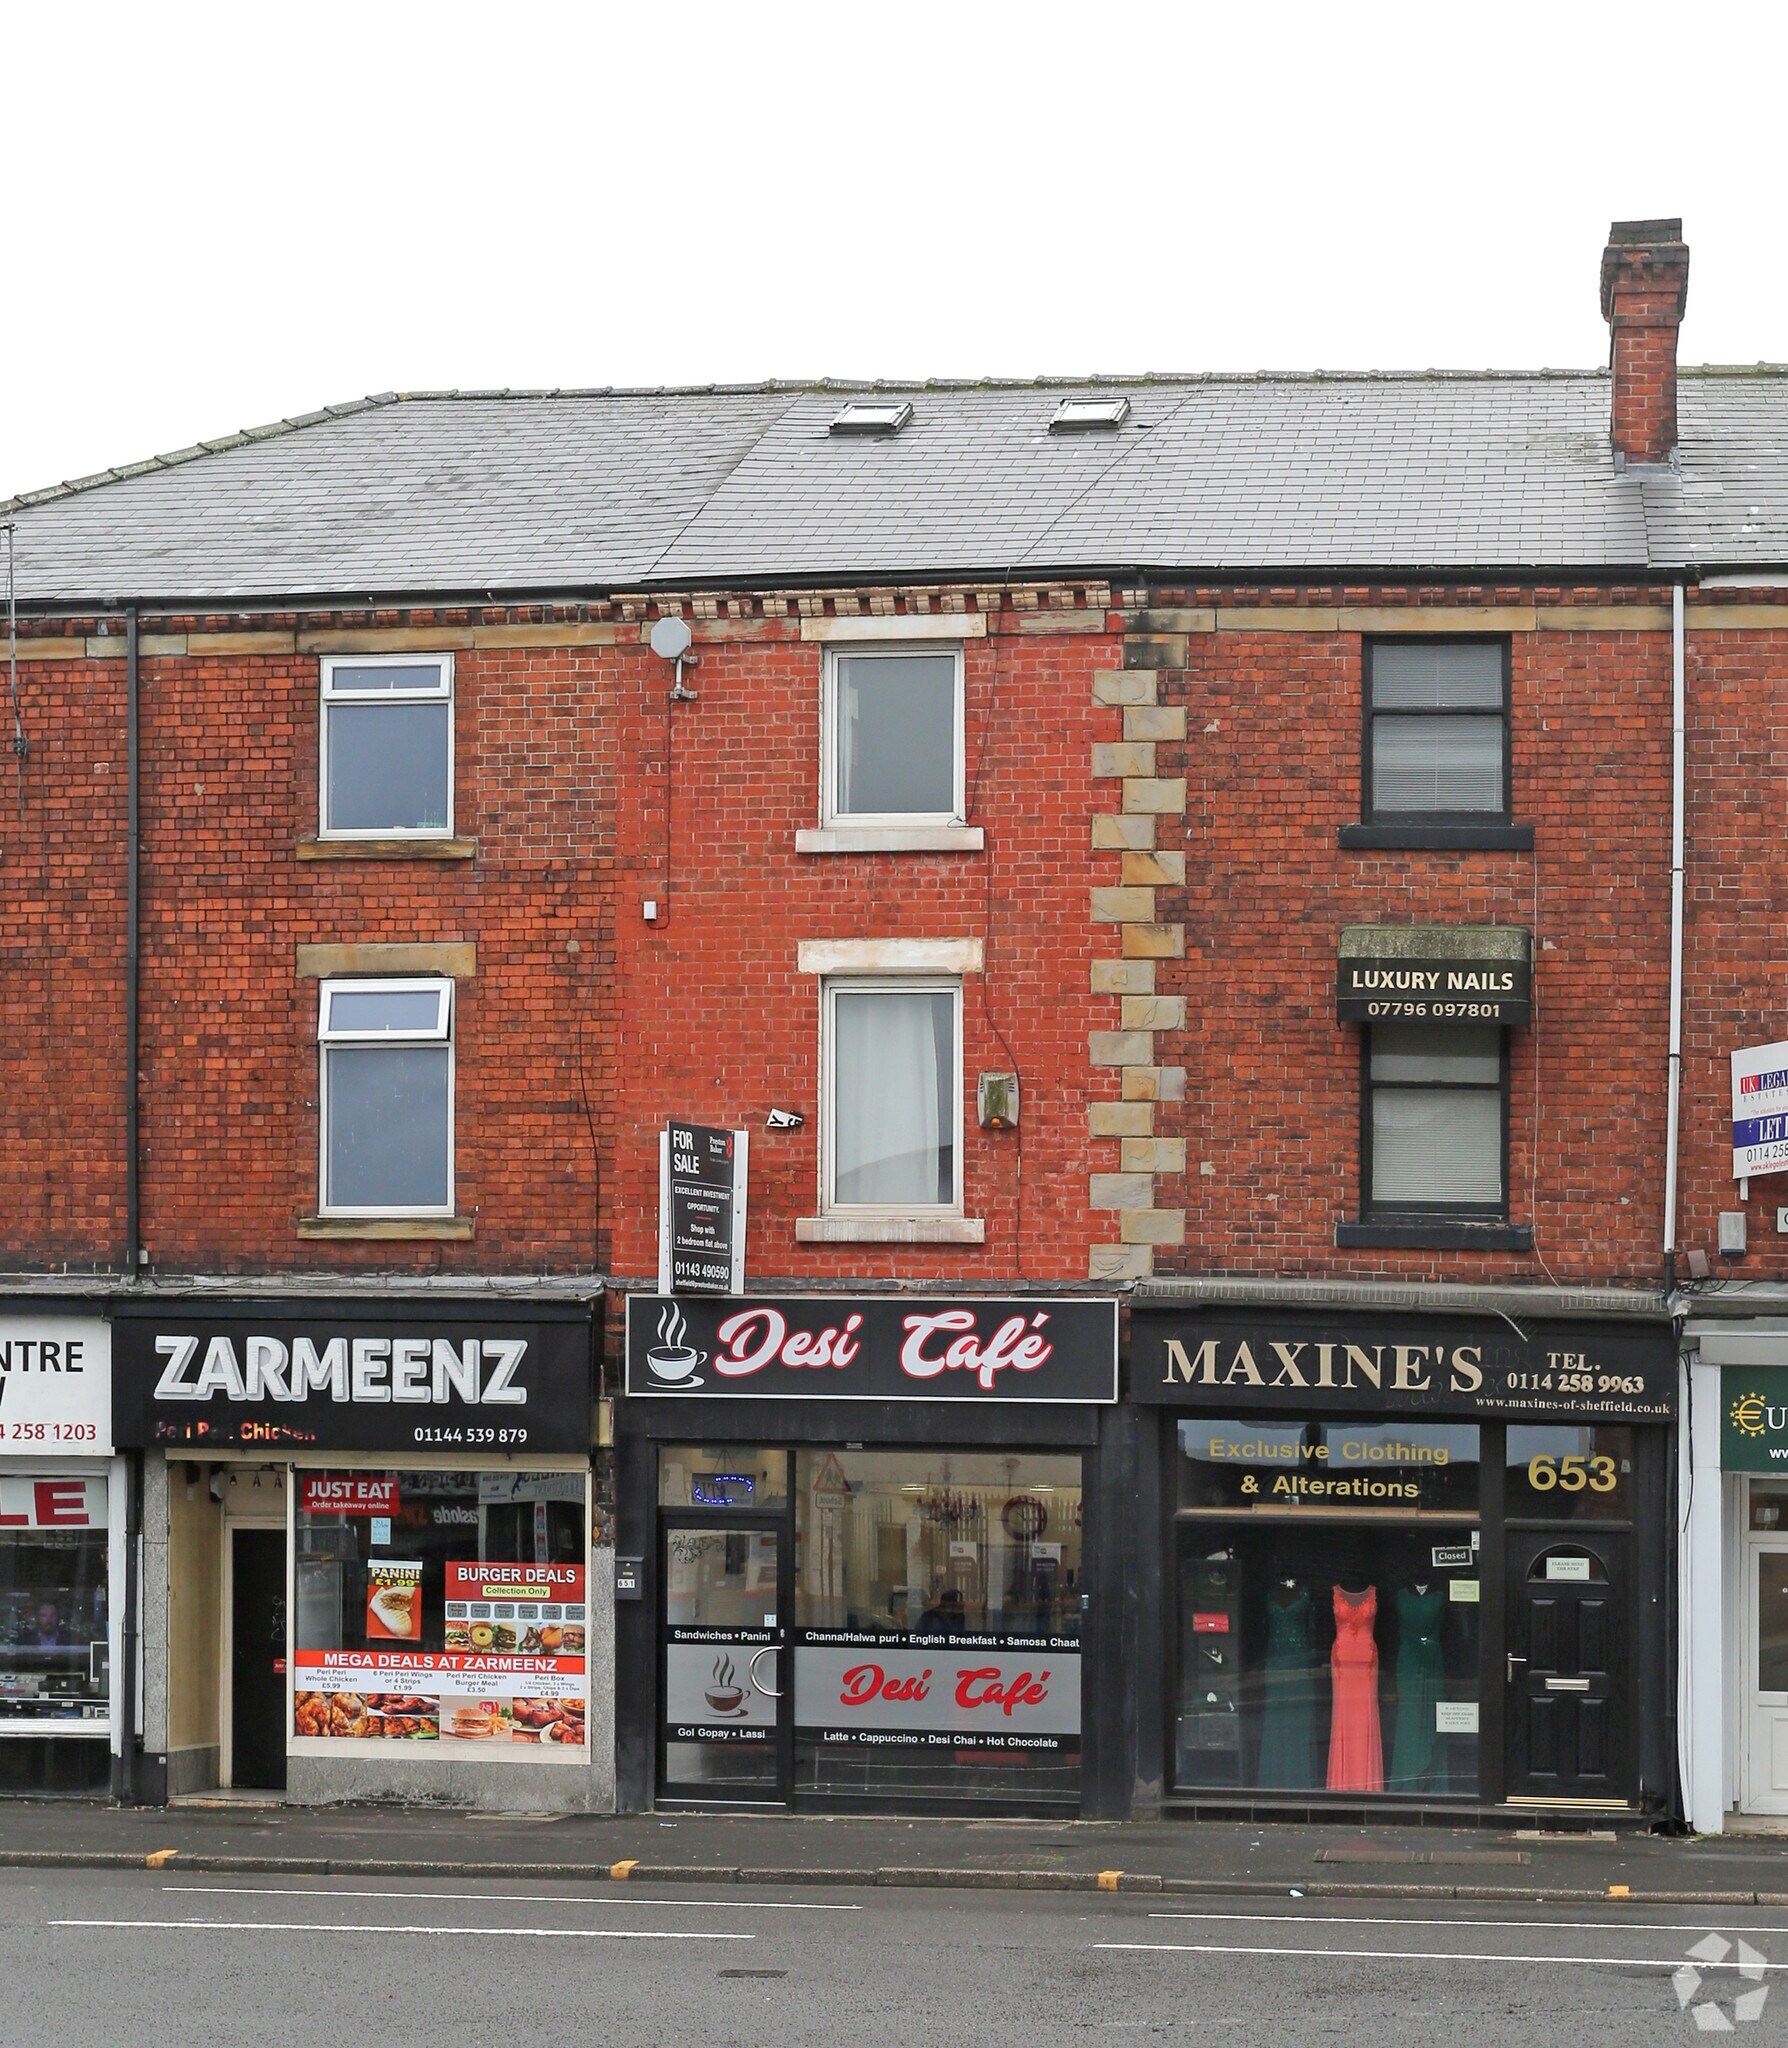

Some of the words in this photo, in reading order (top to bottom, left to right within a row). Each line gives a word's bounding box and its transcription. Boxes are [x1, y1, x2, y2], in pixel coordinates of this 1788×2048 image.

[1352, 970, 1440, 989] LUXURY
[1447, 972, 1514, 991] NAILS
[1367, 1002, 1427, 1016] 07796
[1432, 1003, 1500, 1018] 097801
[1742, 1077, 1756, 1093] UK
[1760, 1070, 1788, 1090] LEGA
[1759, 1116, 1782, 1141] LET
[673, 1129, 694, 1150] FOR
[674, 1153, 700, 1174] SALE
[1746, 1147, 1770, 1162] 0114
[674, 1185, 702, 1197] EXCELLENT
[702, 1189, 730, 1201] INVESTMENT
[690, 1223, 704, 1235] Shop
[704, 1225, 715, 1234] with
[676, 1235, 681, 1244] 2
[681, 1236, 705, 1247] bedroom
[713, 1241, 728, 1250] above
[675, 1261, 700, 1277] 01143
[701, 1264, 729, 1280] 490590
[713, 1306, 864, 1378] Desi
[899, 1308, 1054, 1390] Café
[153, 1335, 529, 1405] ZARMEENZ
[1162, 1339, 1484, 1393] MAXINE'S
[1546, 1352, 1602, 1372] TEL.
[1506, 1372, 1553, 1391] 0114
[1557, 1373, 1594, 1393] 258
[1597, 1375, 1645, 1395] 9963
[1476, 1397, 1671, 1415] www.maxines-of-sheffield.co.uk
[12, 1424, 45, 1440] 258
[53, 1424, 97, 1440] 1203
[414, 1427, 463, 1442] 01144
[466, 1428, 495, 1443] 539
[498, 1428, 528, 1443] 879
[1209, 1438, 1330, 1460] Exclusive
[1342, 1440, 1450, 1466] Clothing
[1528, 1454, 1618, 1493] 653
[307, 1481, 355, 1499] JUST
[357, 1482, 394, 1499] EAT
[1240, 1476, 1260, 1494] &
[1272, 1475, 1419, 1498] Alterations
[311, 1501, 332, 1509] Order
[333, 1501, 367, 1510] takeaway
[367, 1502, 390, 1510] online
[1438, 1551, 1466, 1561] Closed
[371, 1567, 421, 1580] PANINI
[375, 1578, 416, 1587] £1.99
[457, 1567, 522, 1583] BURGER
[525, 1568, 576, 1583] DEALS
[485, 1586, 527, 1596] Collection
[528, 1587, 548, 1597] Only
[674, 1630, 733, 1640] Sandwiches
[740, 1631, 771, 1641] Panini
[805, 1631, 876, 1643] Channa/Halwa
[879, 1634, 899, 1645] puri
[909, 1634, 946, 1646] English
[949, 1635, 997, 1646] Breakfast
[1007, 1636, 1047, 1647] Samosa
[1050, 1637, 1080, 1647] Chaat
[324, 1653, 374, 1667] MEGA
[378, 1654, 434, 1669] DEALS
[437, 1656, 460, 1669] AT
[463, 1657, 558, 1672] ZARMEENZ
[839, 1663, 933, 1706] Desi
[954, 1667, 1052, 1717] Café
[677, 1728, 695, 1738] Gol
[698, 1728, 730, 1739] Gopay
[740, 1729, 766, 1739] Lassi
[823, 1731, 849, 1742] Latte
[859, 1732, 918, 1744] Cappuccino
[928, 1735, 950, 1744] Desi
[953, 1736, 977, 1745] Chai
[986, 1736, 1005, 1746] Hot
[1007, 1737, 1059, 1748] Chocolate
